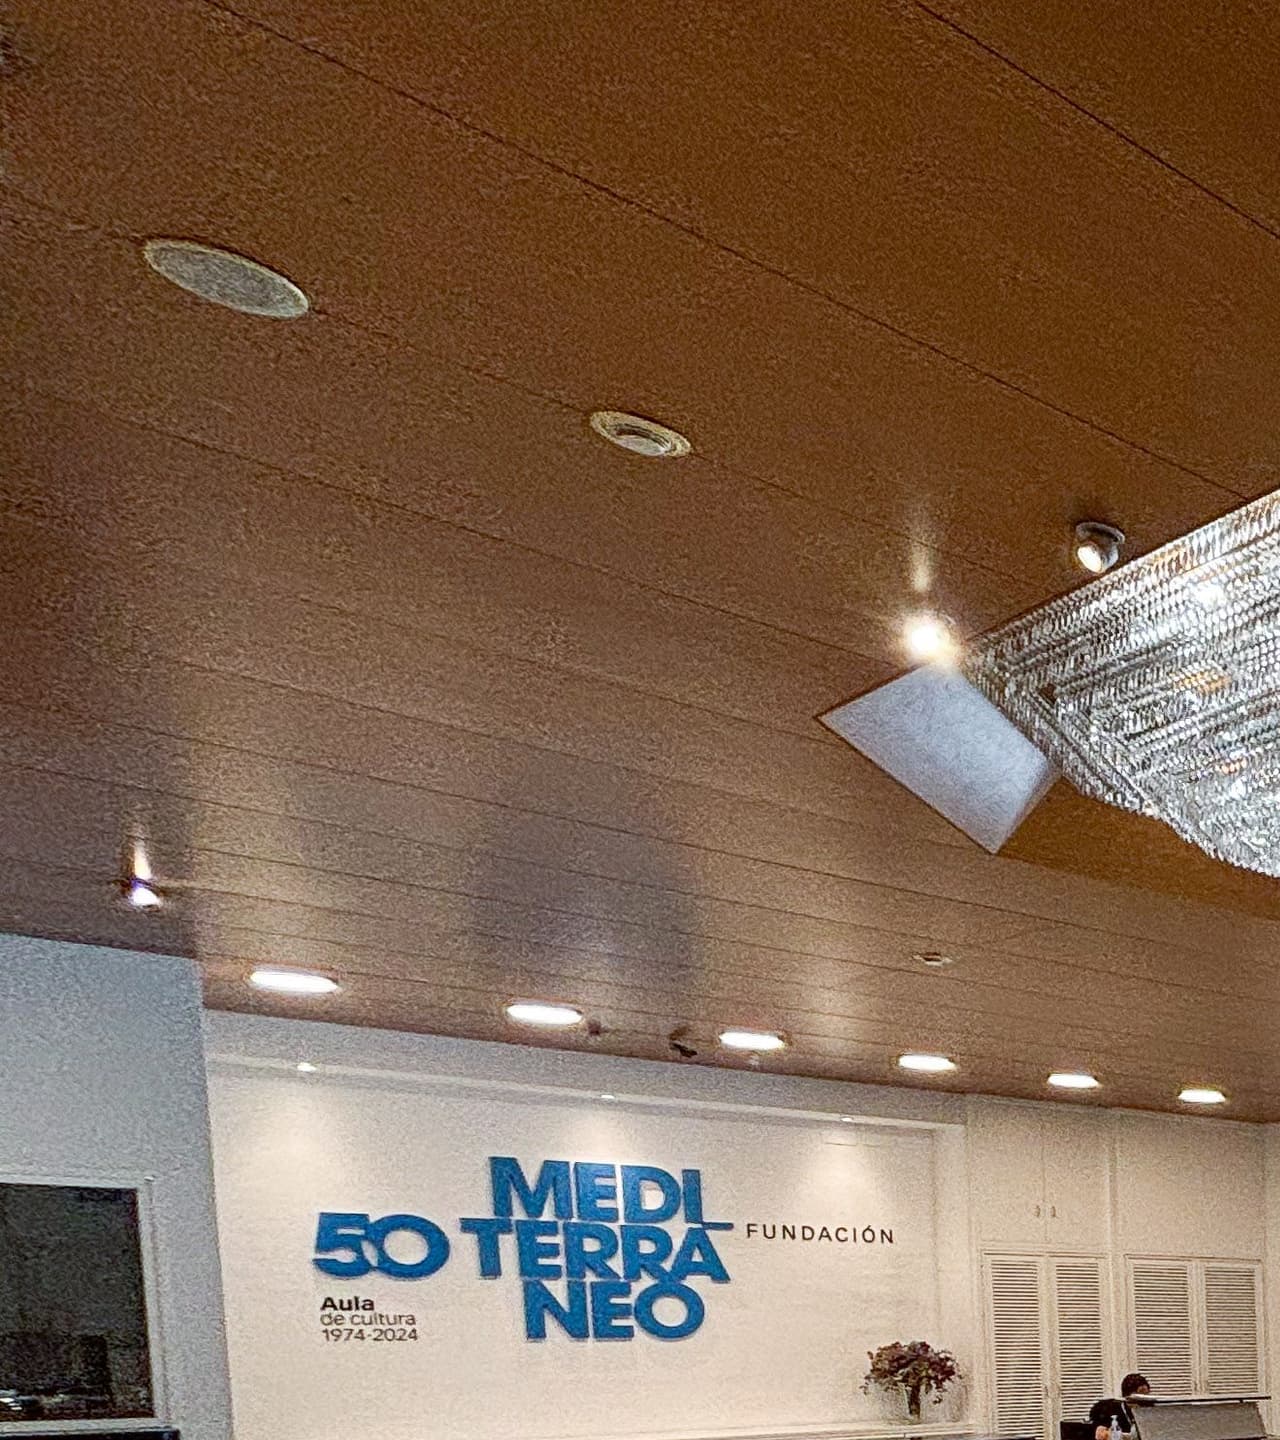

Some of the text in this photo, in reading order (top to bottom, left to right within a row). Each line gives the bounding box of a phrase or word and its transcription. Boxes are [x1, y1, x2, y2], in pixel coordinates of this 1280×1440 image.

[489, 1156, 704, 1224] MEDI
[312, 1212, 451, 1281] 50
[459, 1216, 732, 1283] TERRA
[745, 1221, 896, 1245] FUNDACIÓN
[320, 1296, 375, 1312] Aula
[320, 1311, 416, 1326] de cultura
[522, 1277, 706, 1342] NEO
[321, 1328, 418, 1342] 1974-2024
